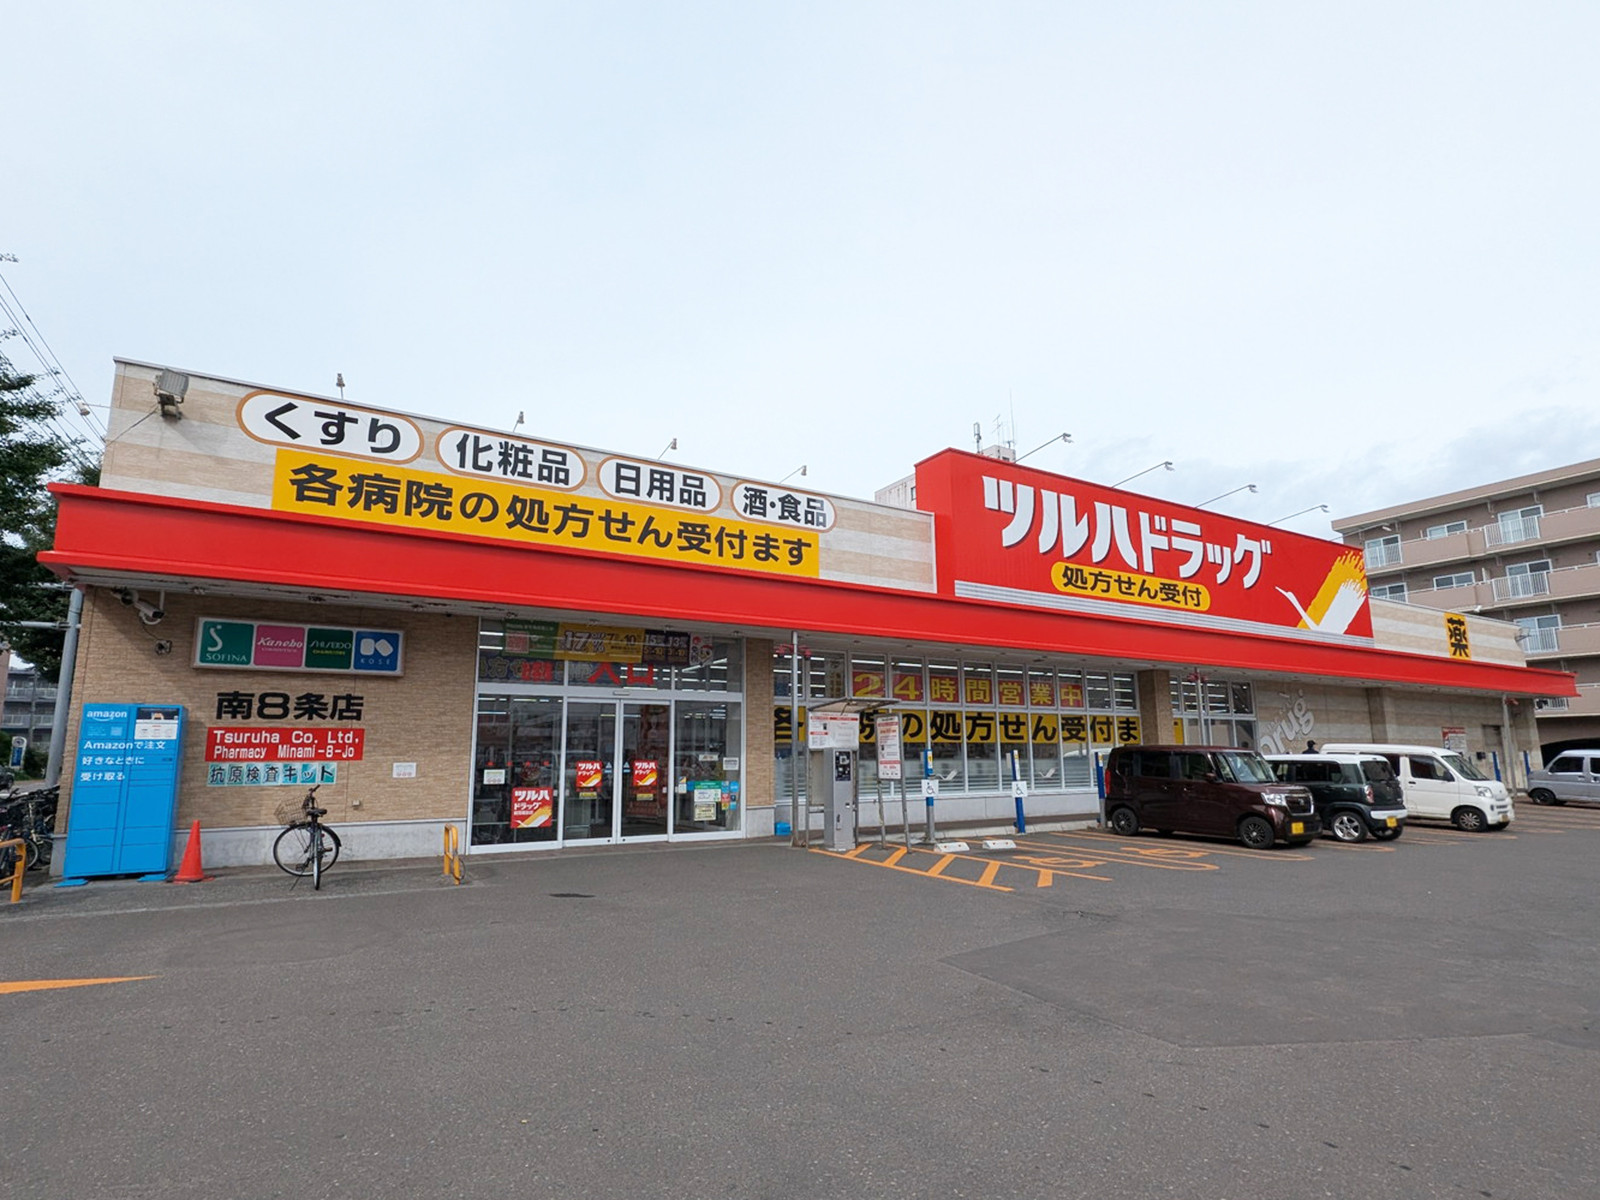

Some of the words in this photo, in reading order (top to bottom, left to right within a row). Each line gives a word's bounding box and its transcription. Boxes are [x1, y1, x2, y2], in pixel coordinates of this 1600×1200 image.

[264, 402, 401, 453] くすり
[456, 432, 571, 486] 化粧品
[614, 462, 707, 509] 日用品
[290, 463, 811, 566] 各病院の処方せん受付ます
[743, 486, 827, 529] 酒・食品
[982, 475, 1271, 589] ツルハドラッグ
[1061, 565, 1203, 607] 処方せん受付
[257, 637, 303, 649] Kanebo
[309, 639, 352, 650] SHISEIDO
[1447, 617, 1469, 657] 薬
[205, 652, 247, 662] SOFINA
[853, 673, 1082, 706] 24時間営業中
[215, 690, 364, 721] 南8条店
[86, 711, 127, 720] amazon
[213, 730, 280, 744] Tsuruha
[291, 730, 318, 744] Co.
[83, 741, 166, 750] Amazonで注文
[213, 745, 267, 759] Pharmacy
[277, 745, 355, 758] Minami-8-Jo
[82, 756, 145, 765] 好きなときに
[80, 772, 126, 782] 受け取る
[210, 765, 333, 783] 抗原検査キット
[514, 790, 550, 801] ツルハ
[513, 802, 542, 811] ドラッグ
